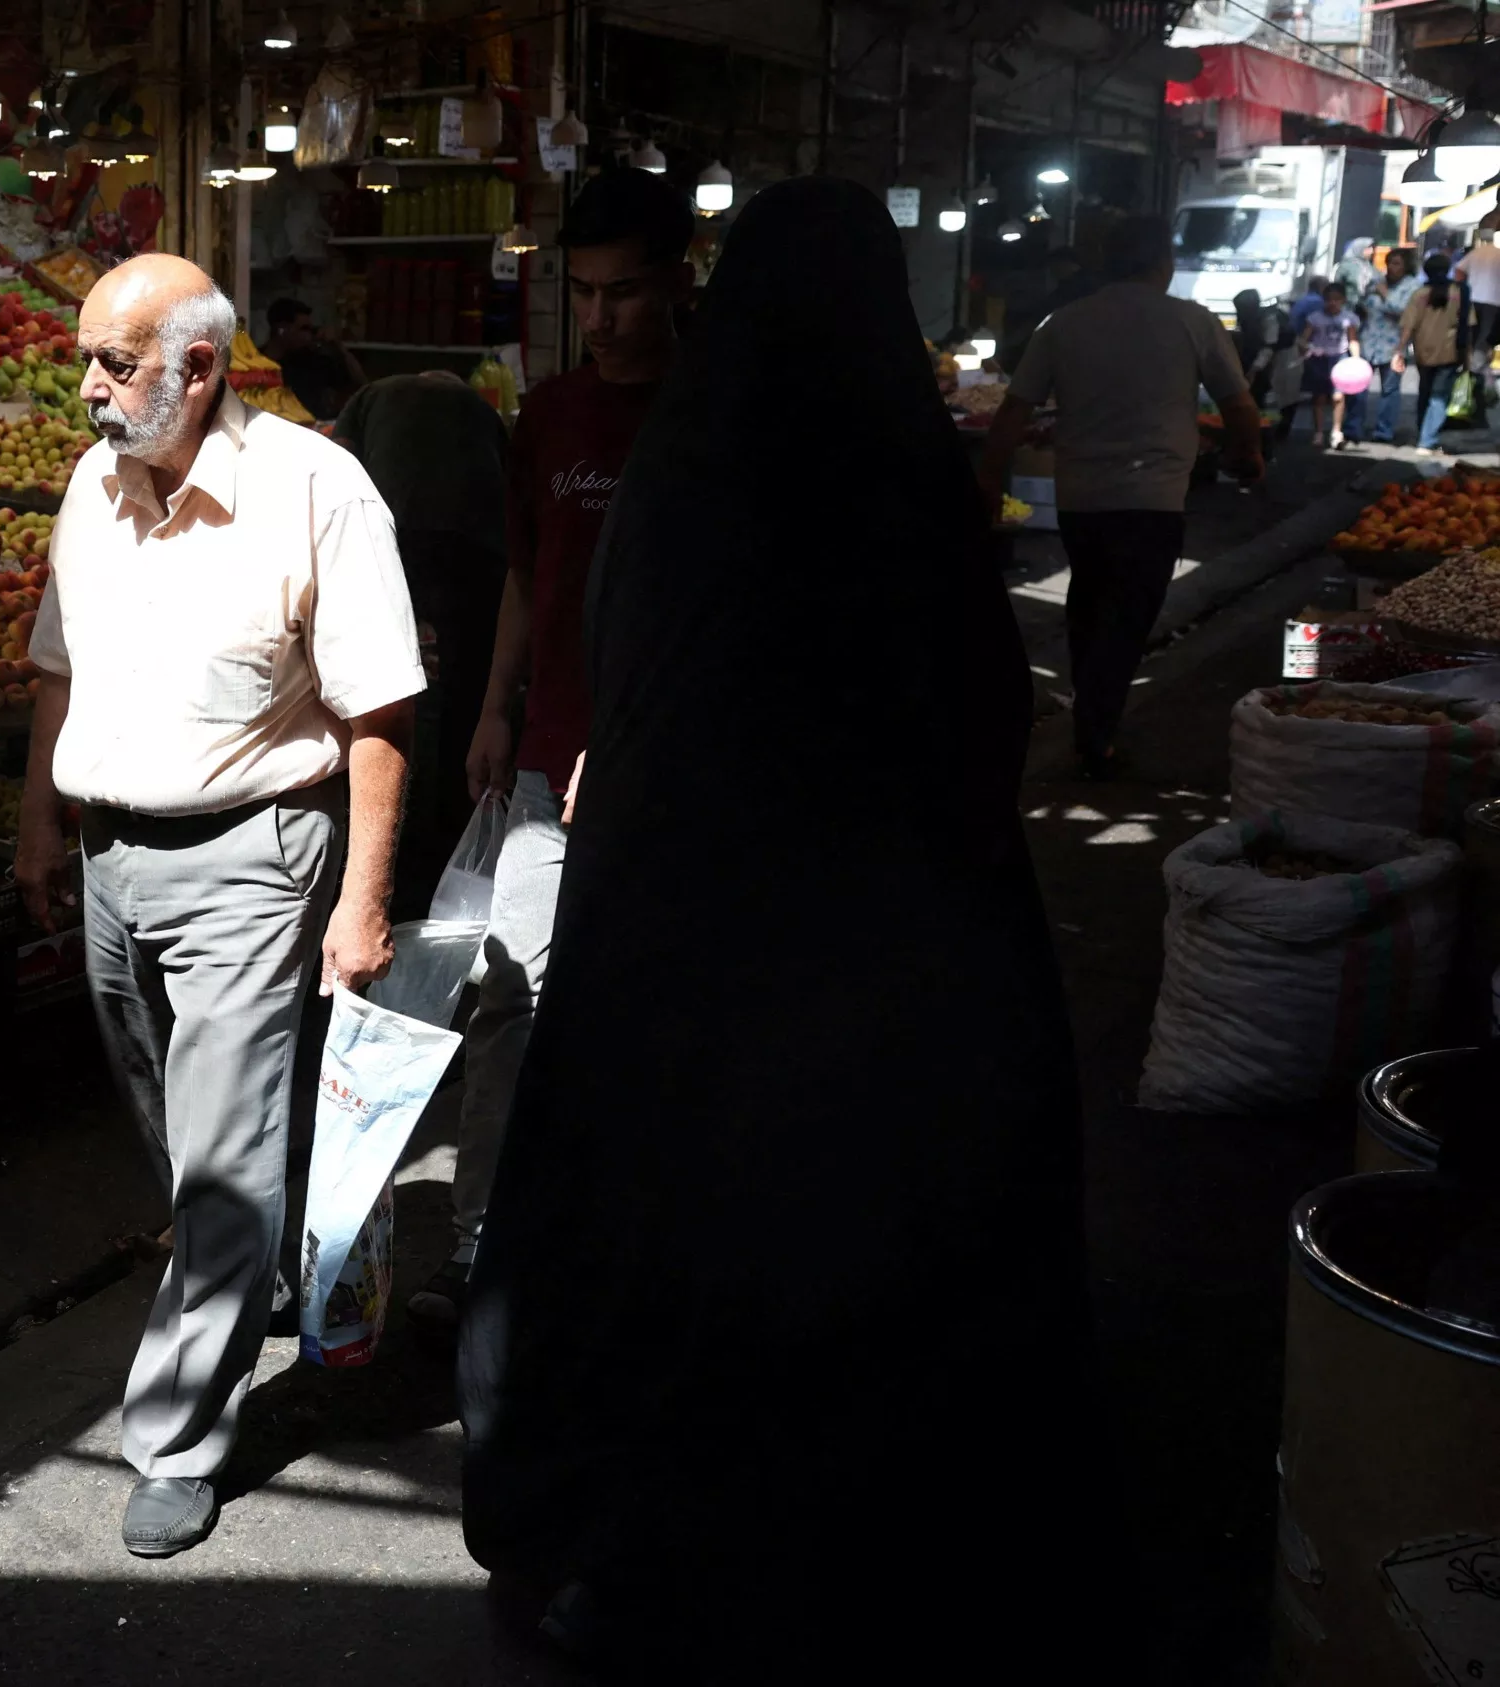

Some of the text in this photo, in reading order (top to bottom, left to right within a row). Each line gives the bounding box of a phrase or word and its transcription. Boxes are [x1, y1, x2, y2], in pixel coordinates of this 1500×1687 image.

[551, 459, 619, 501] Urba
[582, 498, 610, 510] GOO
[1467, 1659, 1484, 1680] 6
